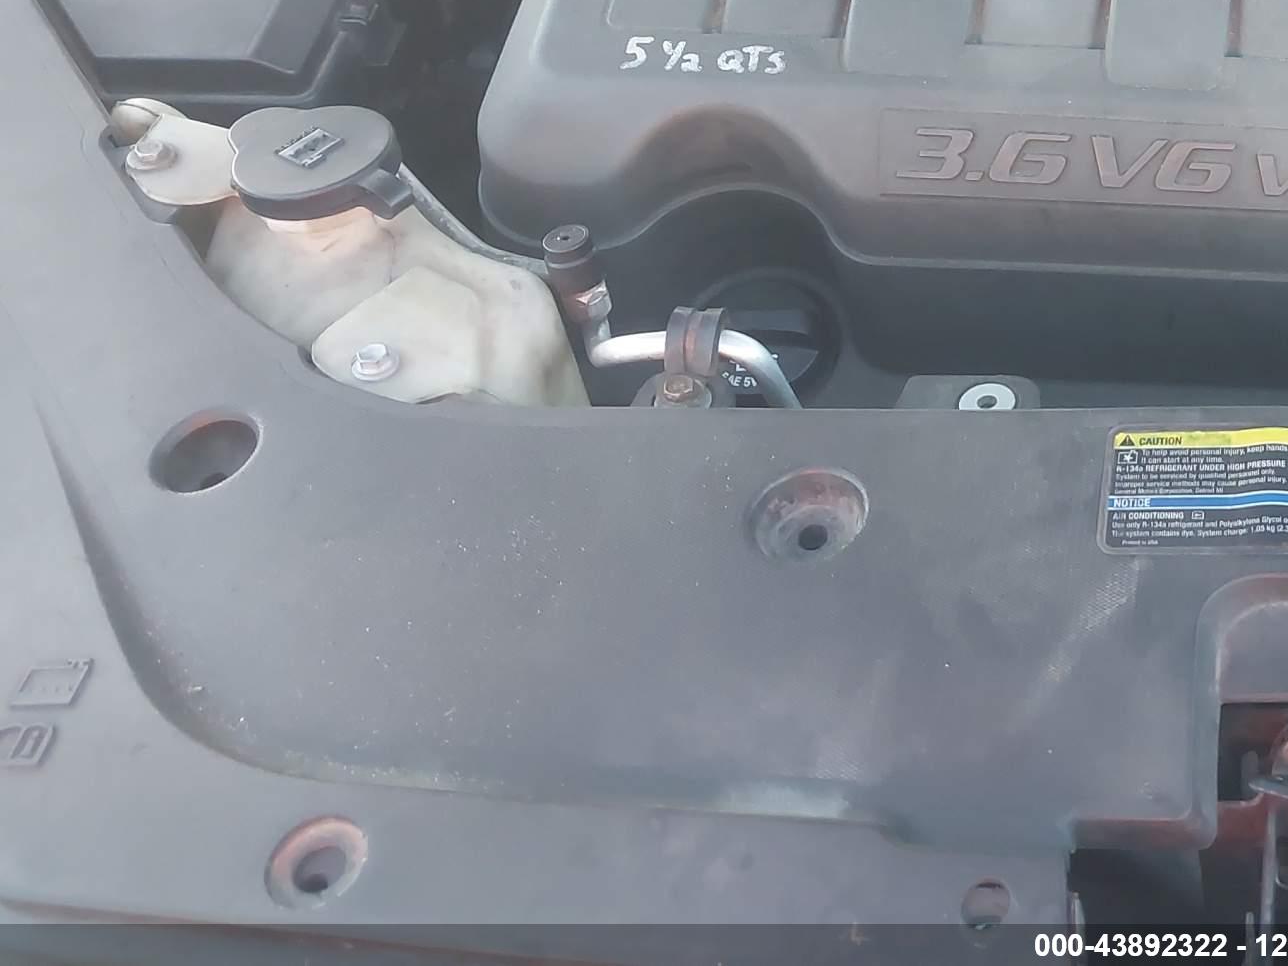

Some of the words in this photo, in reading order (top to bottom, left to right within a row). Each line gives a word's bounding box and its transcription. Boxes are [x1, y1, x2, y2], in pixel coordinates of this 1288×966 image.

[620, 36, 655, 70] 5
[896, 128, 1072, 185] 3.6
[1091, 134, 1237, 194] V6
[1247, 446, 1264, 454] keep
[1266, 444, 1288, 452] hands
[1227, 463, 1245, 471] HIGH
[1247, 460, 1286, 469] PRESSURE
[1228, 469, 1259, 479] personnel
[1238, 477, 1265, 486] personal
[1267, 476, 1287, 484] injury.
[1113, 498, 1151, 507] NOTICE
[1262, 516, 1282, 524] Glycol
[1197, 529, 1222, 537] System
[1251, 525, 1265, 533] 1.05
[1267, 525, 1275, 533] kg
